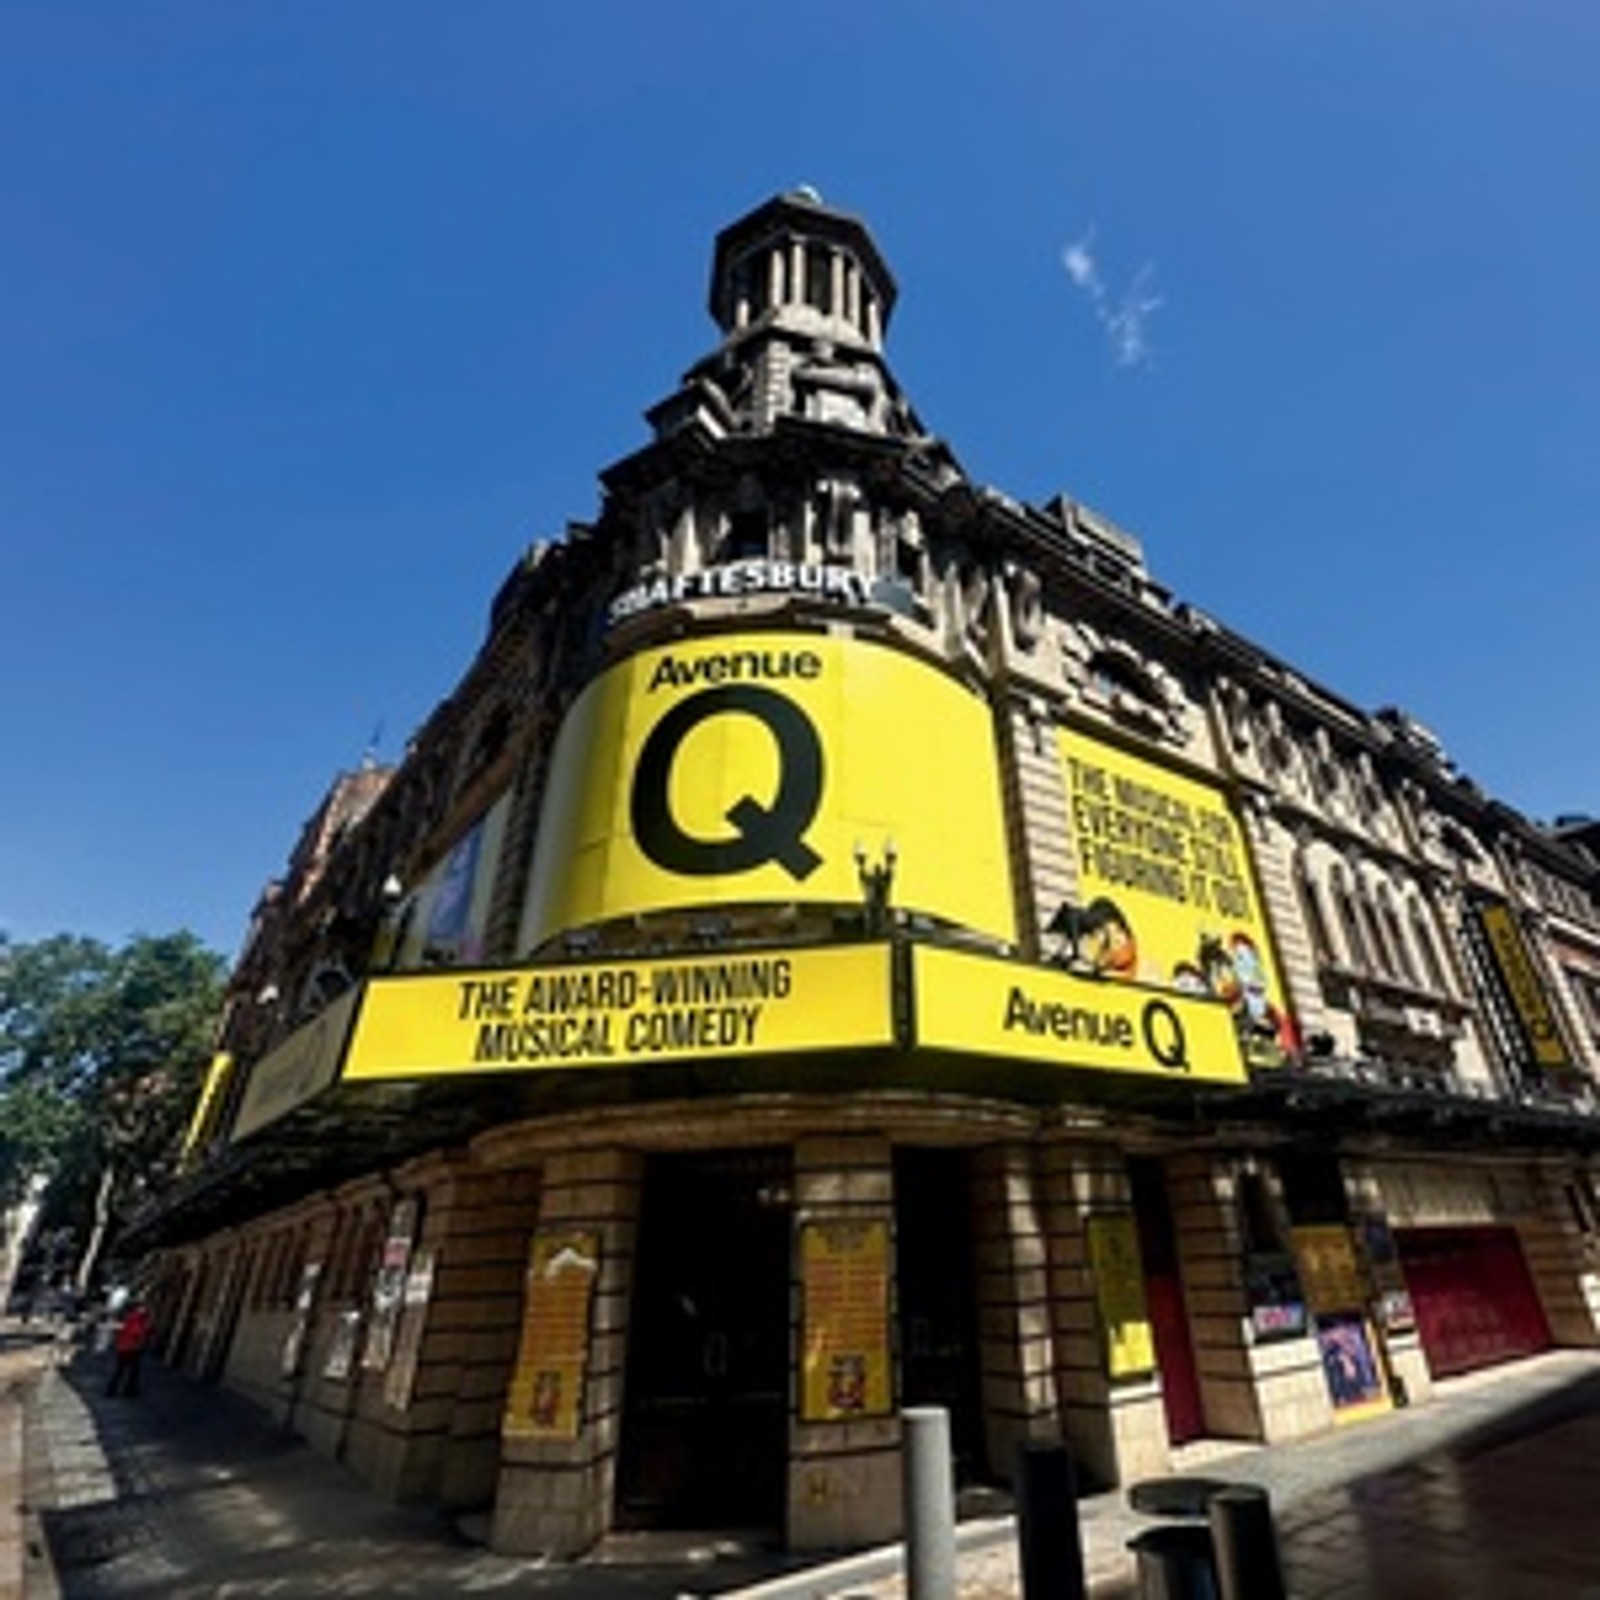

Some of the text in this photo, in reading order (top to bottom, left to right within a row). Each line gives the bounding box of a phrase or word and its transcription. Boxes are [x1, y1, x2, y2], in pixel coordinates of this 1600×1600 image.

[649, 650, 822, 692] Avenue
[630, 683, 826, 882] Q
[1067, 757, 1110, 800] THE
[1072, 795, 1187, 864] EVERYONE
[1078, 837, 1186, 903] FIGURING
[458, 959, 793, 1021] THE AWARD-WINNING
[474, 1004, 763, 1063] MUSICAL COMEDY
[1003, 986, 1191, 1073] Avenue Q
